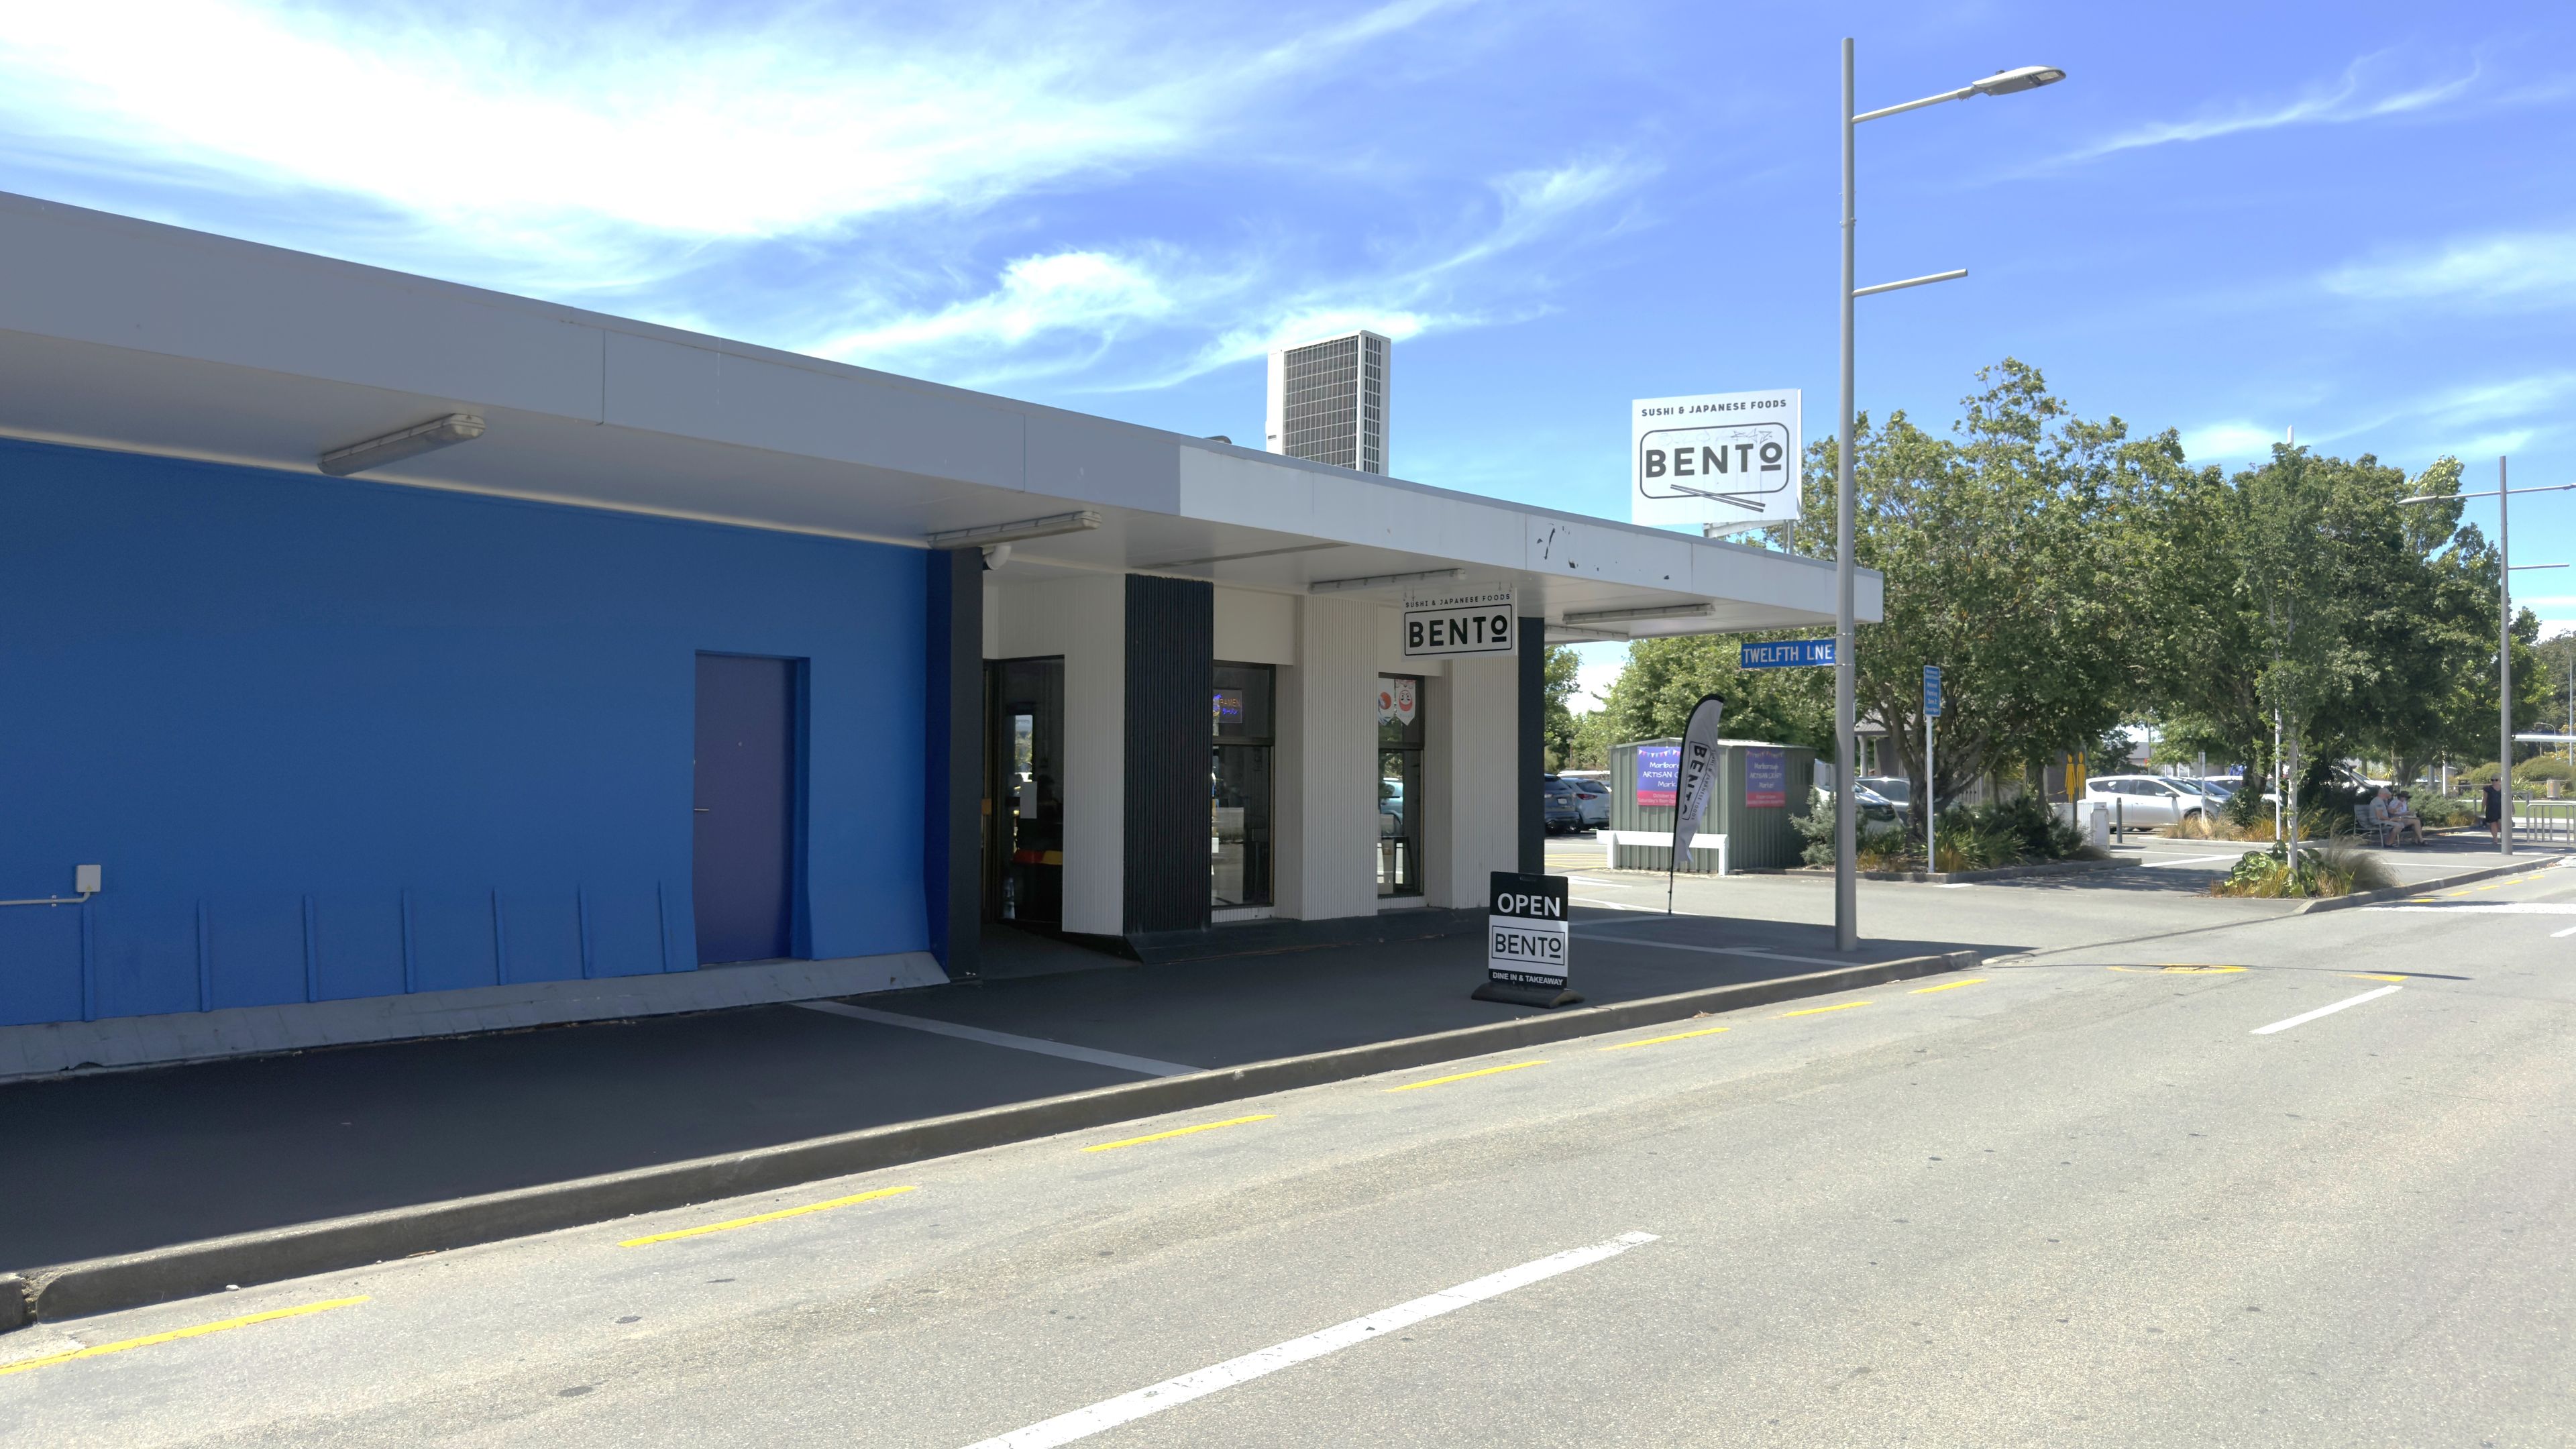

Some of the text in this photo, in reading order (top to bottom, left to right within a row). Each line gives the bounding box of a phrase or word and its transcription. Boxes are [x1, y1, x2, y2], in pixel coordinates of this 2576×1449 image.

[1642, 408, 1674, 417] SUSHI
[1689, 402, 1746, 413] JAPANESE
[1750, 399, 1786, 409] FOODS
[1646, 441, 1782, 478] BENTO
[1440, 596, 1479, 605] JAPANESE
[1482, 594, 1511, 602] FOODS
[1409, 615, 1507, 648] BENTO
[1743, 644, 1833, 664] TWELFTH LNE
[1497, 893, 1560, 917] OPEN
[1495, 933, 1561, 959] BENTO
[1493, 971, 1509, 980] DINE
[1525, 975, 1563, 985] TAKEAWAY
